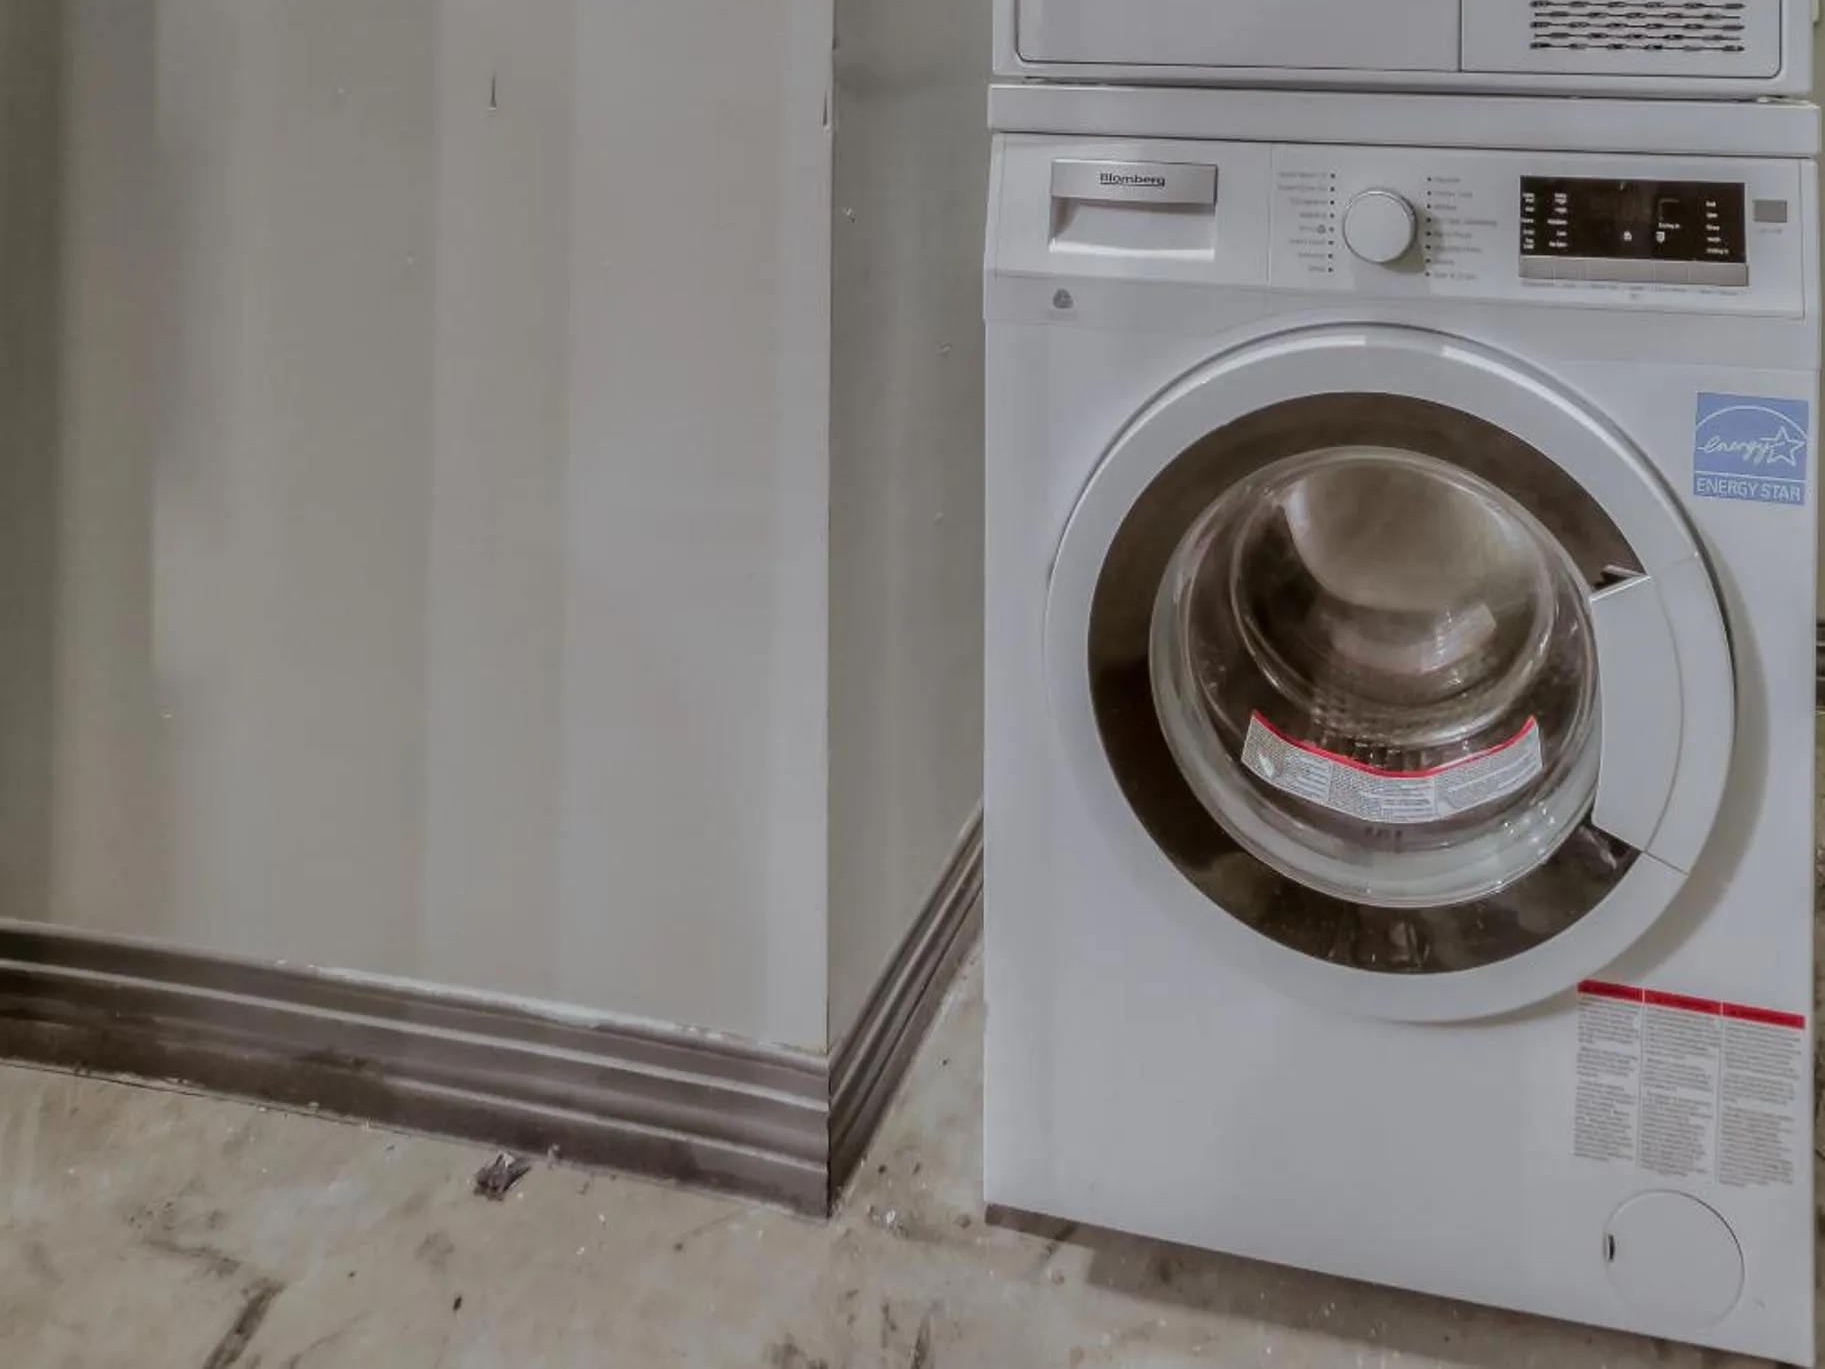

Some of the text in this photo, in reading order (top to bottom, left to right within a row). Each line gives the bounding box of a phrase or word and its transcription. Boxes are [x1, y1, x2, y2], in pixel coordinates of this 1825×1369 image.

[1099, 172, 1166, 188] Blomberg
[1696, 477, 1801, 502] ENERGY STAR
